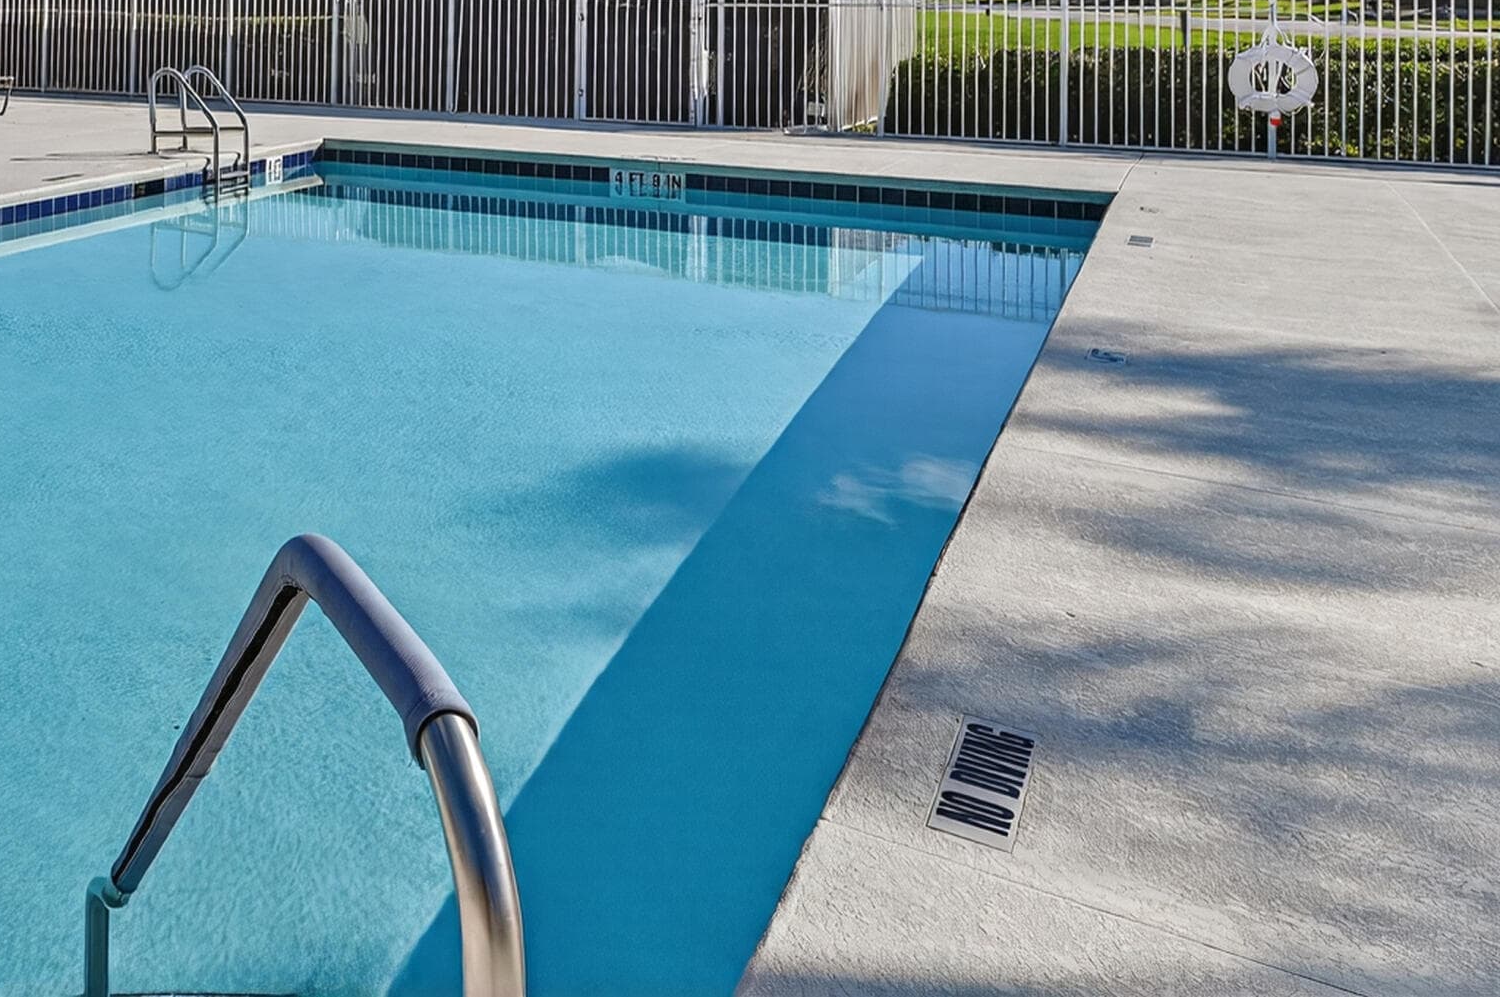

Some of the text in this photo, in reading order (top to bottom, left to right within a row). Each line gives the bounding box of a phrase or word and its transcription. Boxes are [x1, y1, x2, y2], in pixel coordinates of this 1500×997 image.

[667, 174, 682, 190] IN
[936, 723, 1035, 837] NO DIVING
